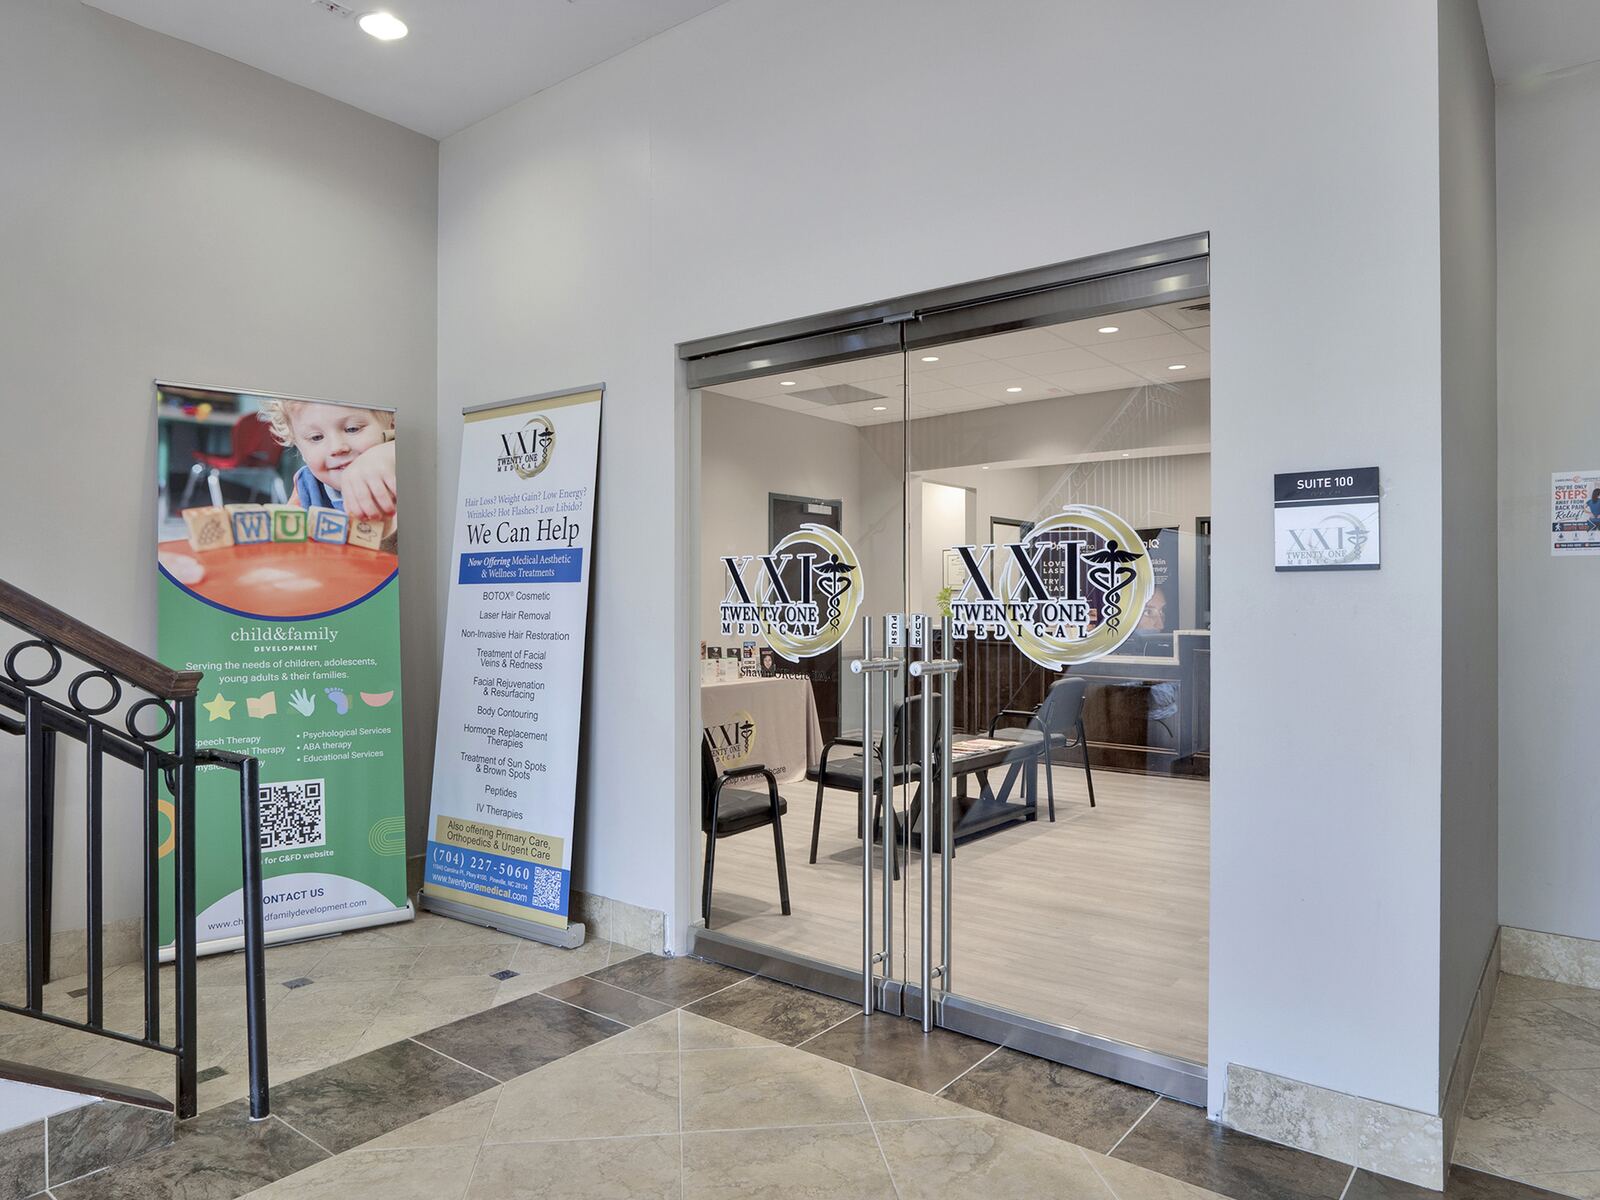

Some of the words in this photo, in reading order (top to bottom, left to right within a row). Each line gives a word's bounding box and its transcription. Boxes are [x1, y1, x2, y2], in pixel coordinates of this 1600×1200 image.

[498, 456, 522, 466] TWENTY
[525, 454, 538, 462] ONE
[498, 464, 538, 472] MEDICAL
[1297, 478, 1331, 490] SUITE
[1335, 476, 1353, 486] 100
[465, 497, 478, 507] Hair
[480, 496, 497, 506] Loss?
[498, 494, 520, 505] Weight
[522, 492, 542, 501] Gain?
[543, 490, 557, 500] Low
[559, 488, 587, 500] Energy?
[1555, 490, 1587, 500] STEPS
[468, 508, 496, 518] Wrinkles?
[498, 508, 510, 517] Hot
[512, 506, 538, 516] Flashes?
[540, 504, 554, 514] Low
[556, 502, 582, 512] Libido?
[468, 524, 491, 544] We
[496, 522, 530, 543] Can
[534, 516, 580, 547] Help
[468, 558, 482, 567] Now
[484, 556, 510, 568] Offering
[512, 555, 538, 565] Medical
[540, 555, 571, 564] Aesthetic
[1286, 551, 1324, 559] TWENTY
[481, 570, 487, 578] &
[489, 568, 516, 578] Wellness
[518, 568, 554, 577] Treatments
[952, 540, 1086, 602] XXI
[721, 554, 817, 604] XXI
[516, 591, 550, 600] Cosmetic
[480, 611, 499, 619] Laser
[501, 611, 516, 620] Hair
[518, 611, 551, 620] Removal
[721, 606, 779, 621] TWENTY
[787, 607, 816, 621] ONE
[952, 604, 1034, 622] TWENTY
[1045, 604, 1086, 622] ONE
[231, 627, 339, 642] child&family
[461, 630, 506, 638] Non-Invasive
[508, 630, 523, 639] Hair
[526, 630, 570, 640] Restoration
[722, 622, 817, 635] MEDICAL
[953, 623, 1087, 638] MEDICAL
[477, 648, 512, 658] Treatment
[514, 650, 522, 658] of
[524, 650, 546, 660] Facial
[185, 662, 222, 672] Serving
[225, 661, 240, 669] the
[242, 660, 270, 669] needs
[273, 660, 282, 668] of
[285, 658, 322, 668] children,
[324, 657, 377, 667] adolescents,
[480, 658, 500, 667] Veins
[502, 660, 507, 668] &
[510, 660, 542, 670] Redness
[219, 674, 248, 684] young
[250, 672, 279, 682] adults
[290, 672, 310, 680] their
[313, 670, 349, 679] families.
[474, 676, 494, 686] Facial
[496, 678, 544, 690] Rejuvenation
[483, 687, 488, 696] &
[491, 688, 534, 701] Resurfacing
[478, 706, 496, 717] Body
[498, 707, 538, 722] Contouring
[303, 728, 357, 739] Psychological
[359, 726, 391, 735] Services
[464, 724, 496, 736] Hormone
[498, 727, 548, 741] Replacement
[226, 736, 261, 744] Therapy
[303, 742, 320, 750] ABA
[322, 740, 352, 750] therapy
[488, 736, 523, 748] Therapies
[252, 746, 286, 756] Therapy
[304, 752, 350, 762] Educational
[352, 750, 384, 760] Services
[461, 752, 496, 766] Treatment
[498, 757, 506, 766] of
[507, 758, 522, 768] Sun
[524, 760, 546, 772] Spots
[476, 764, 481, 772] &
[483, 765, 506, 776] Brown
[508, 769, 530, 780] Spots
[485, 785, 518, 798] Peptides
[476, 803, 484, 812] IV
[486, 804, 524, 820] Therapies
[448, 820, 464, 832] Also
[466, 824, 494, 840] offering
[496, 830, 526, 846] Primary
[528, 836, 550, 850] Care,
[447, 830, 491, 848] Orthopedics
[494, 840, 499, 850] &
[502, 842, 528, 856] Urgent
[530, 848, 550, 860] Care
[265, 856, 277, 864] for
[279, 854, 301, 862] C&FD
[303, 850, 334, 860] website
[433, 848, 465, 867] (704)
[470, 856, 530, 880] 227-5060
[432, 873, 528, 902] www.twentyonemedical.com
[263, 890, 307, 904] ONTACT
[310, 888, 324, 897] US
